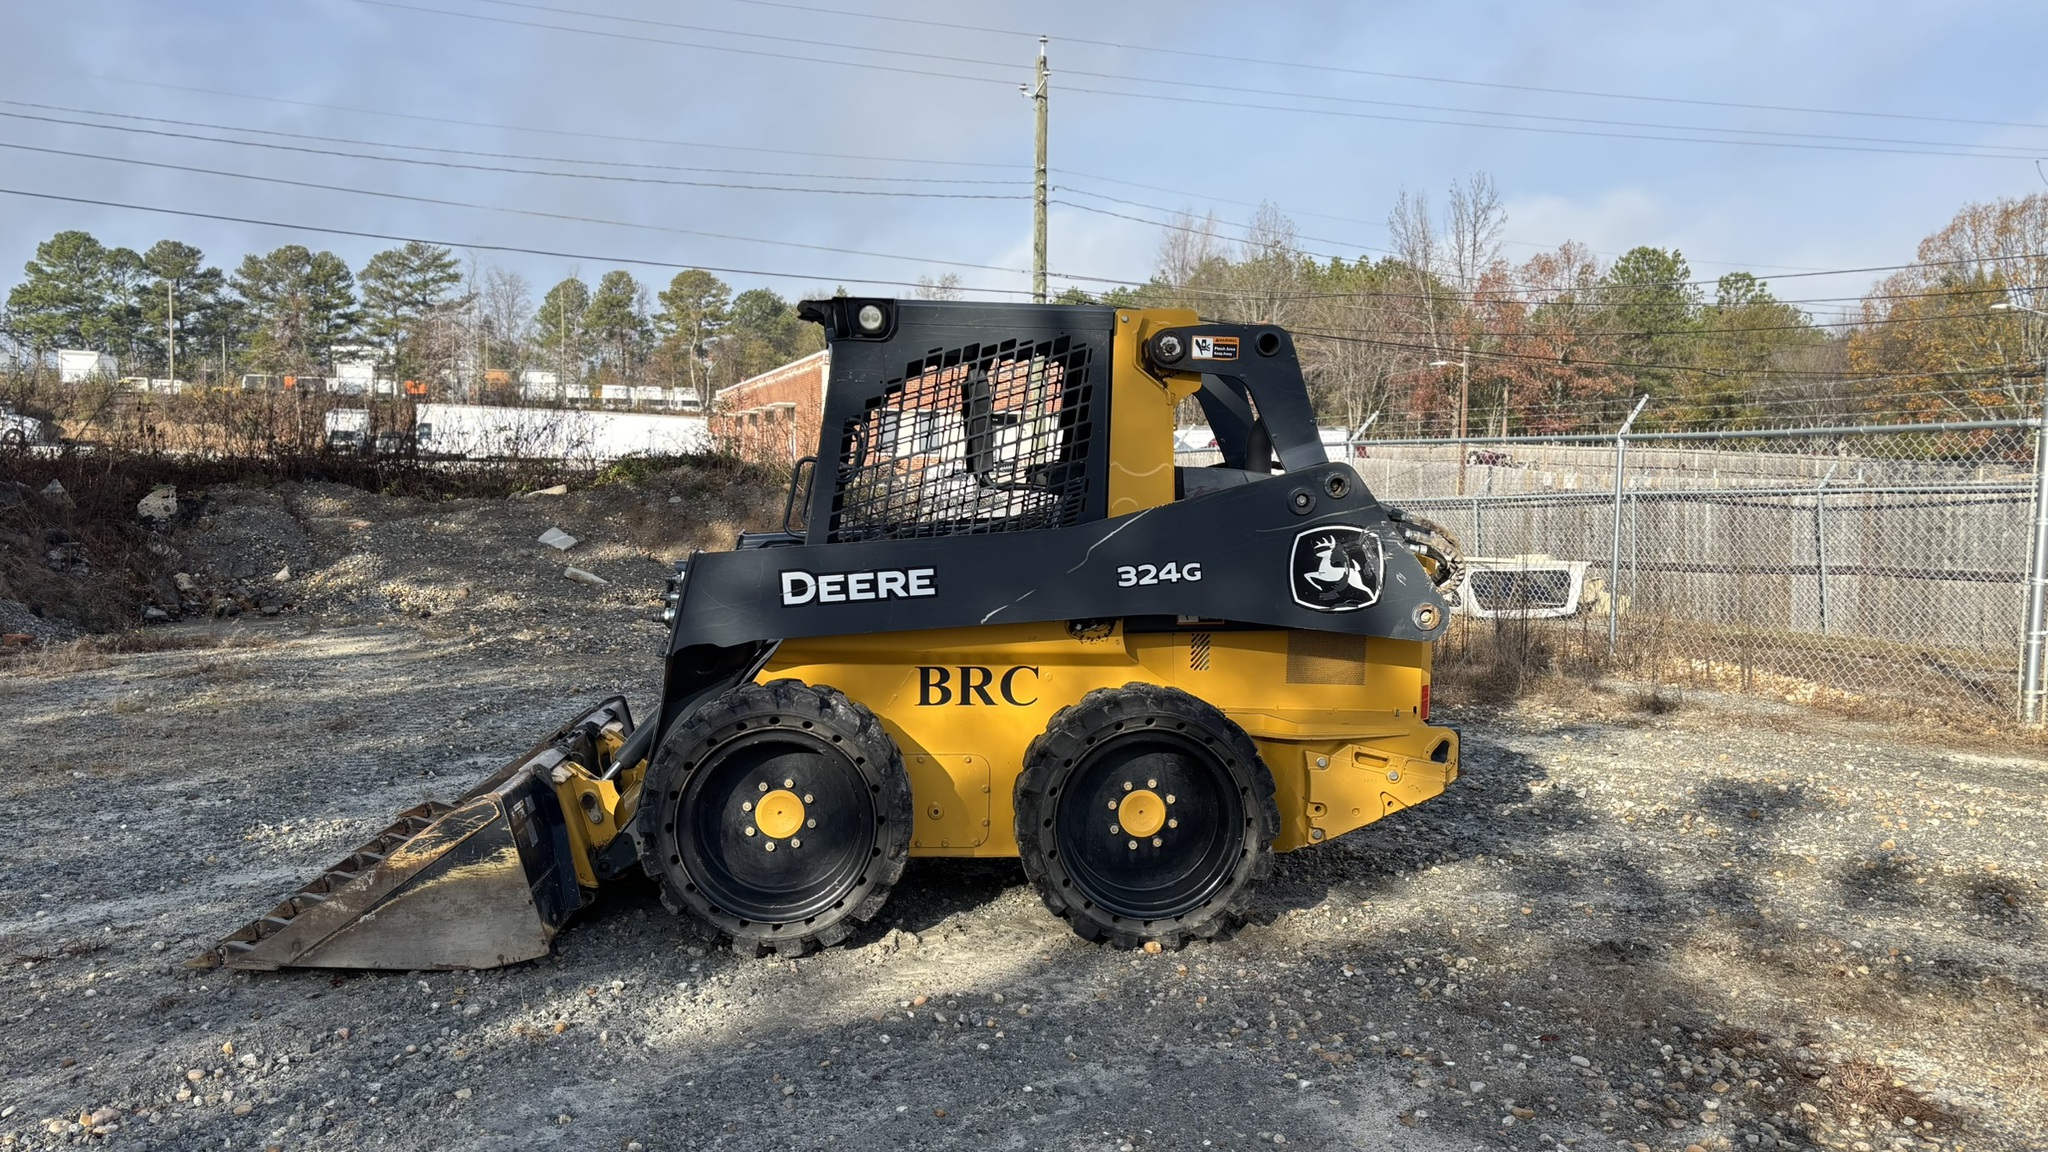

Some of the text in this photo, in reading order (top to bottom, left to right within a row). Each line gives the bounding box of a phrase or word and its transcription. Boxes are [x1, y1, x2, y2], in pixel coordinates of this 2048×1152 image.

[781, 568, 936, 606] DEERE
[1117, 561, 1202, 587] 324G
[914, 665, 1039, 706] BRC
